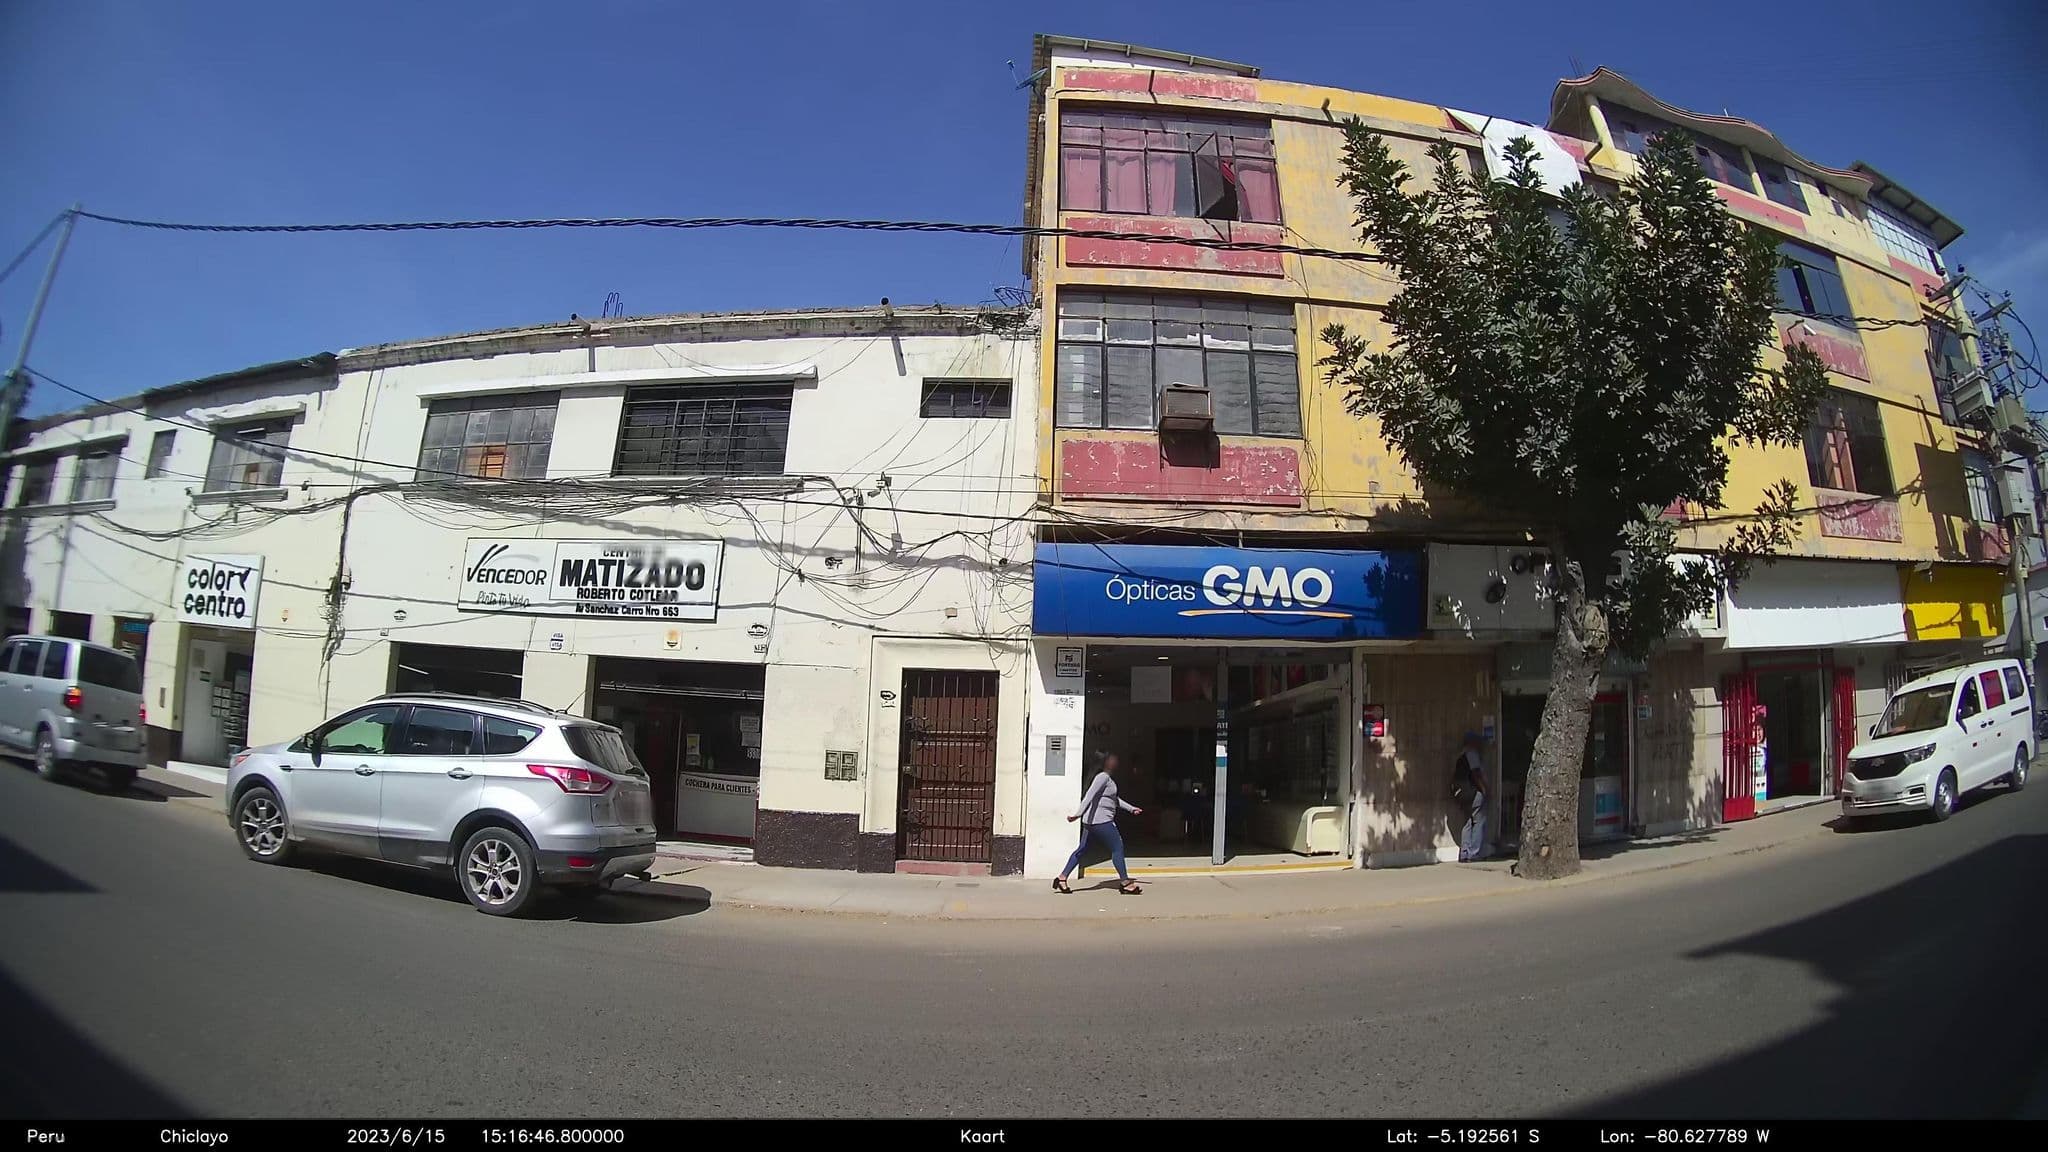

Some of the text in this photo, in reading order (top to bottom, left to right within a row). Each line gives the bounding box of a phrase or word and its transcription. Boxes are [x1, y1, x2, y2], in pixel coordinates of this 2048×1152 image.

[188, 563, 237, 591] color
[467, 552, 547, 585] VENCEDOR
[559, 559, 706, 590] MATIZADO
[576, 587, 625, 601] ROBERTO
[1106, 565, 1333, 608] Ópticas GMO
[184, 591, 245, 619] centro
[645, 606, 660, 616] Nro
[726, 784, 751, 794] CLIENTES
